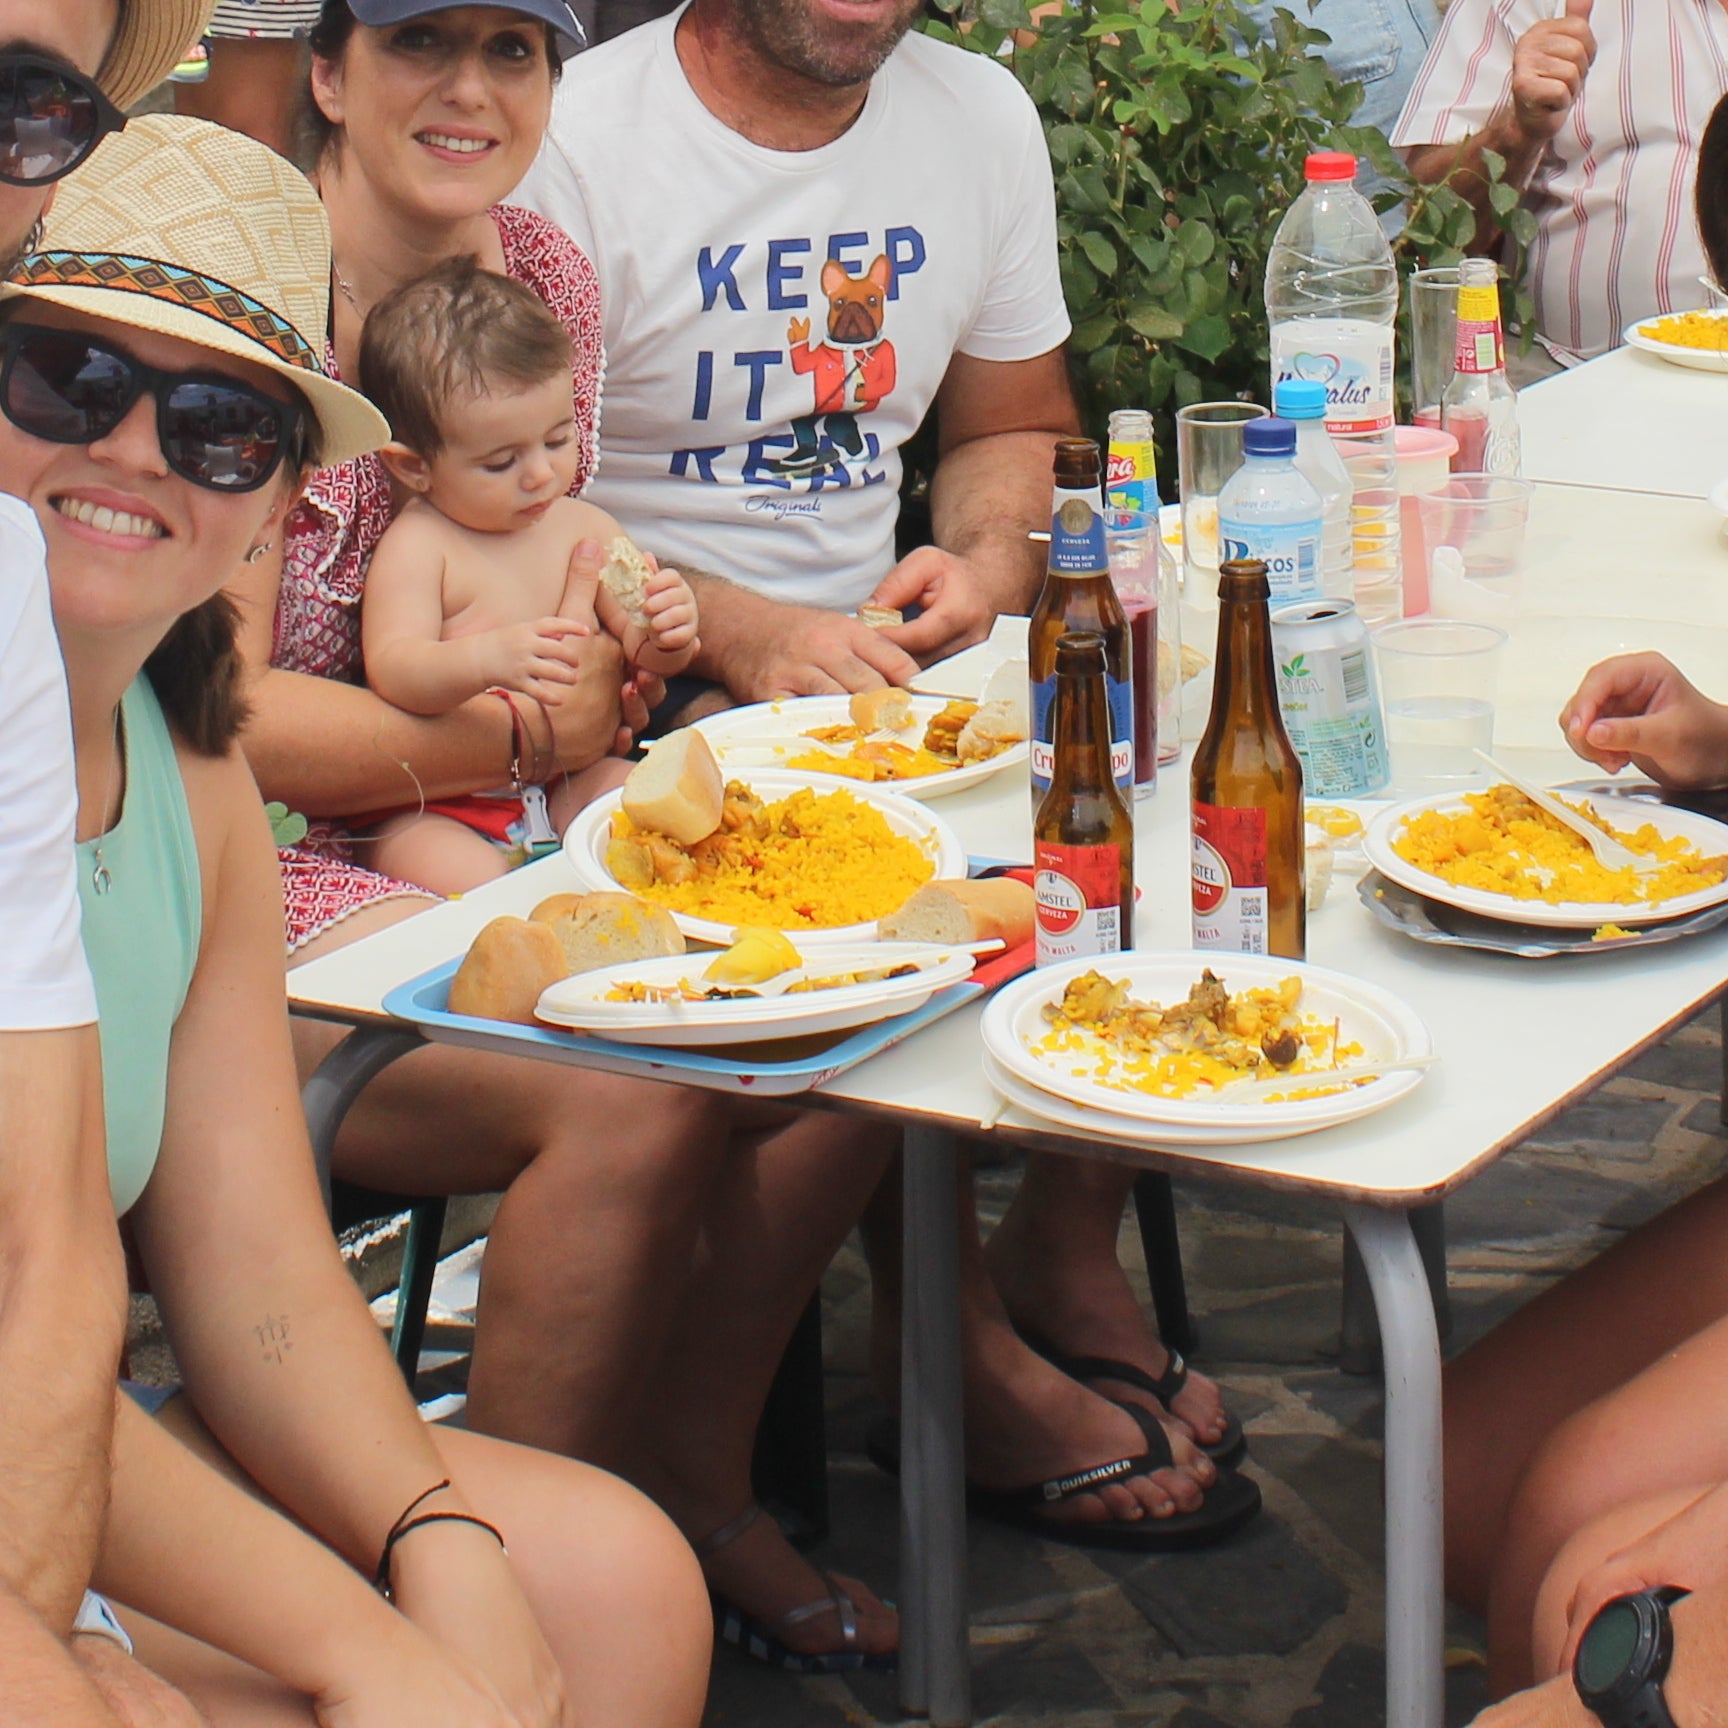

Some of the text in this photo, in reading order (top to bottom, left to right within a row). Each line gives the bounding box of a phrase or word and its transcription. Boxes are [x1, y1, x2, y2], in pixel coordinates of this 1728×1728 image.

[697, 226, 927, 312] KEEP
[691, 350, 783, 421] IT
[745, 494, 821, 521] Originals
[1060, 1459, 1132, 1491] QUIKSILVER
